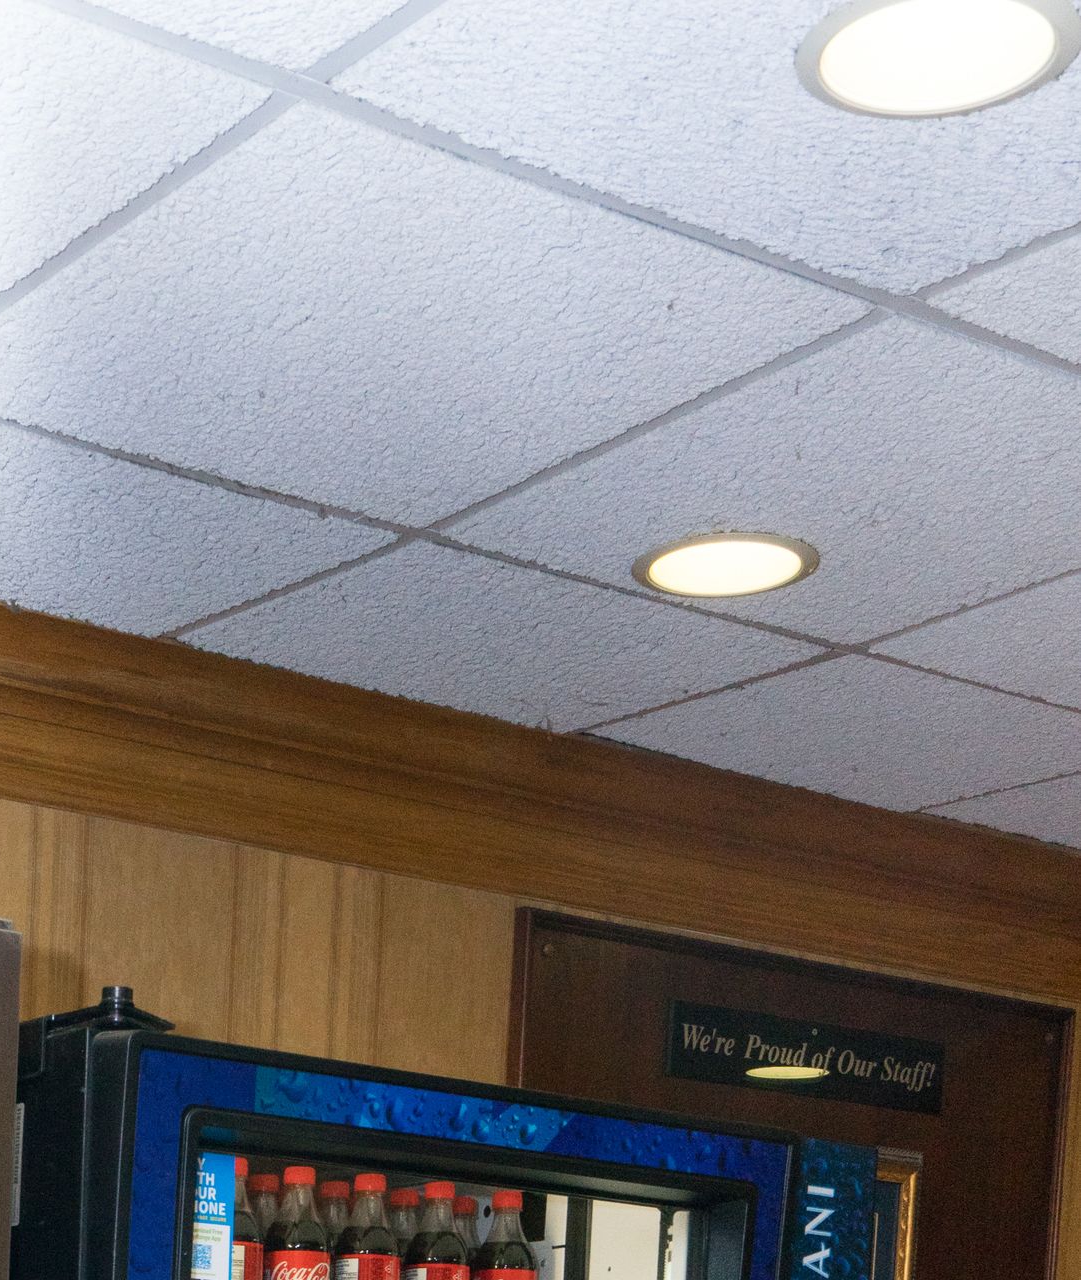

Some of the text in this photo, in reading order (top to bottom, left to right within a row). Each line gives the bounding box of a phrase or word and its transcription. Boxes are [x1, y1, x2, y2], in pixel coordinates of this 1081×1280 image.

[682, 1023, 936, 1091] We're Proud of Our Staff!
